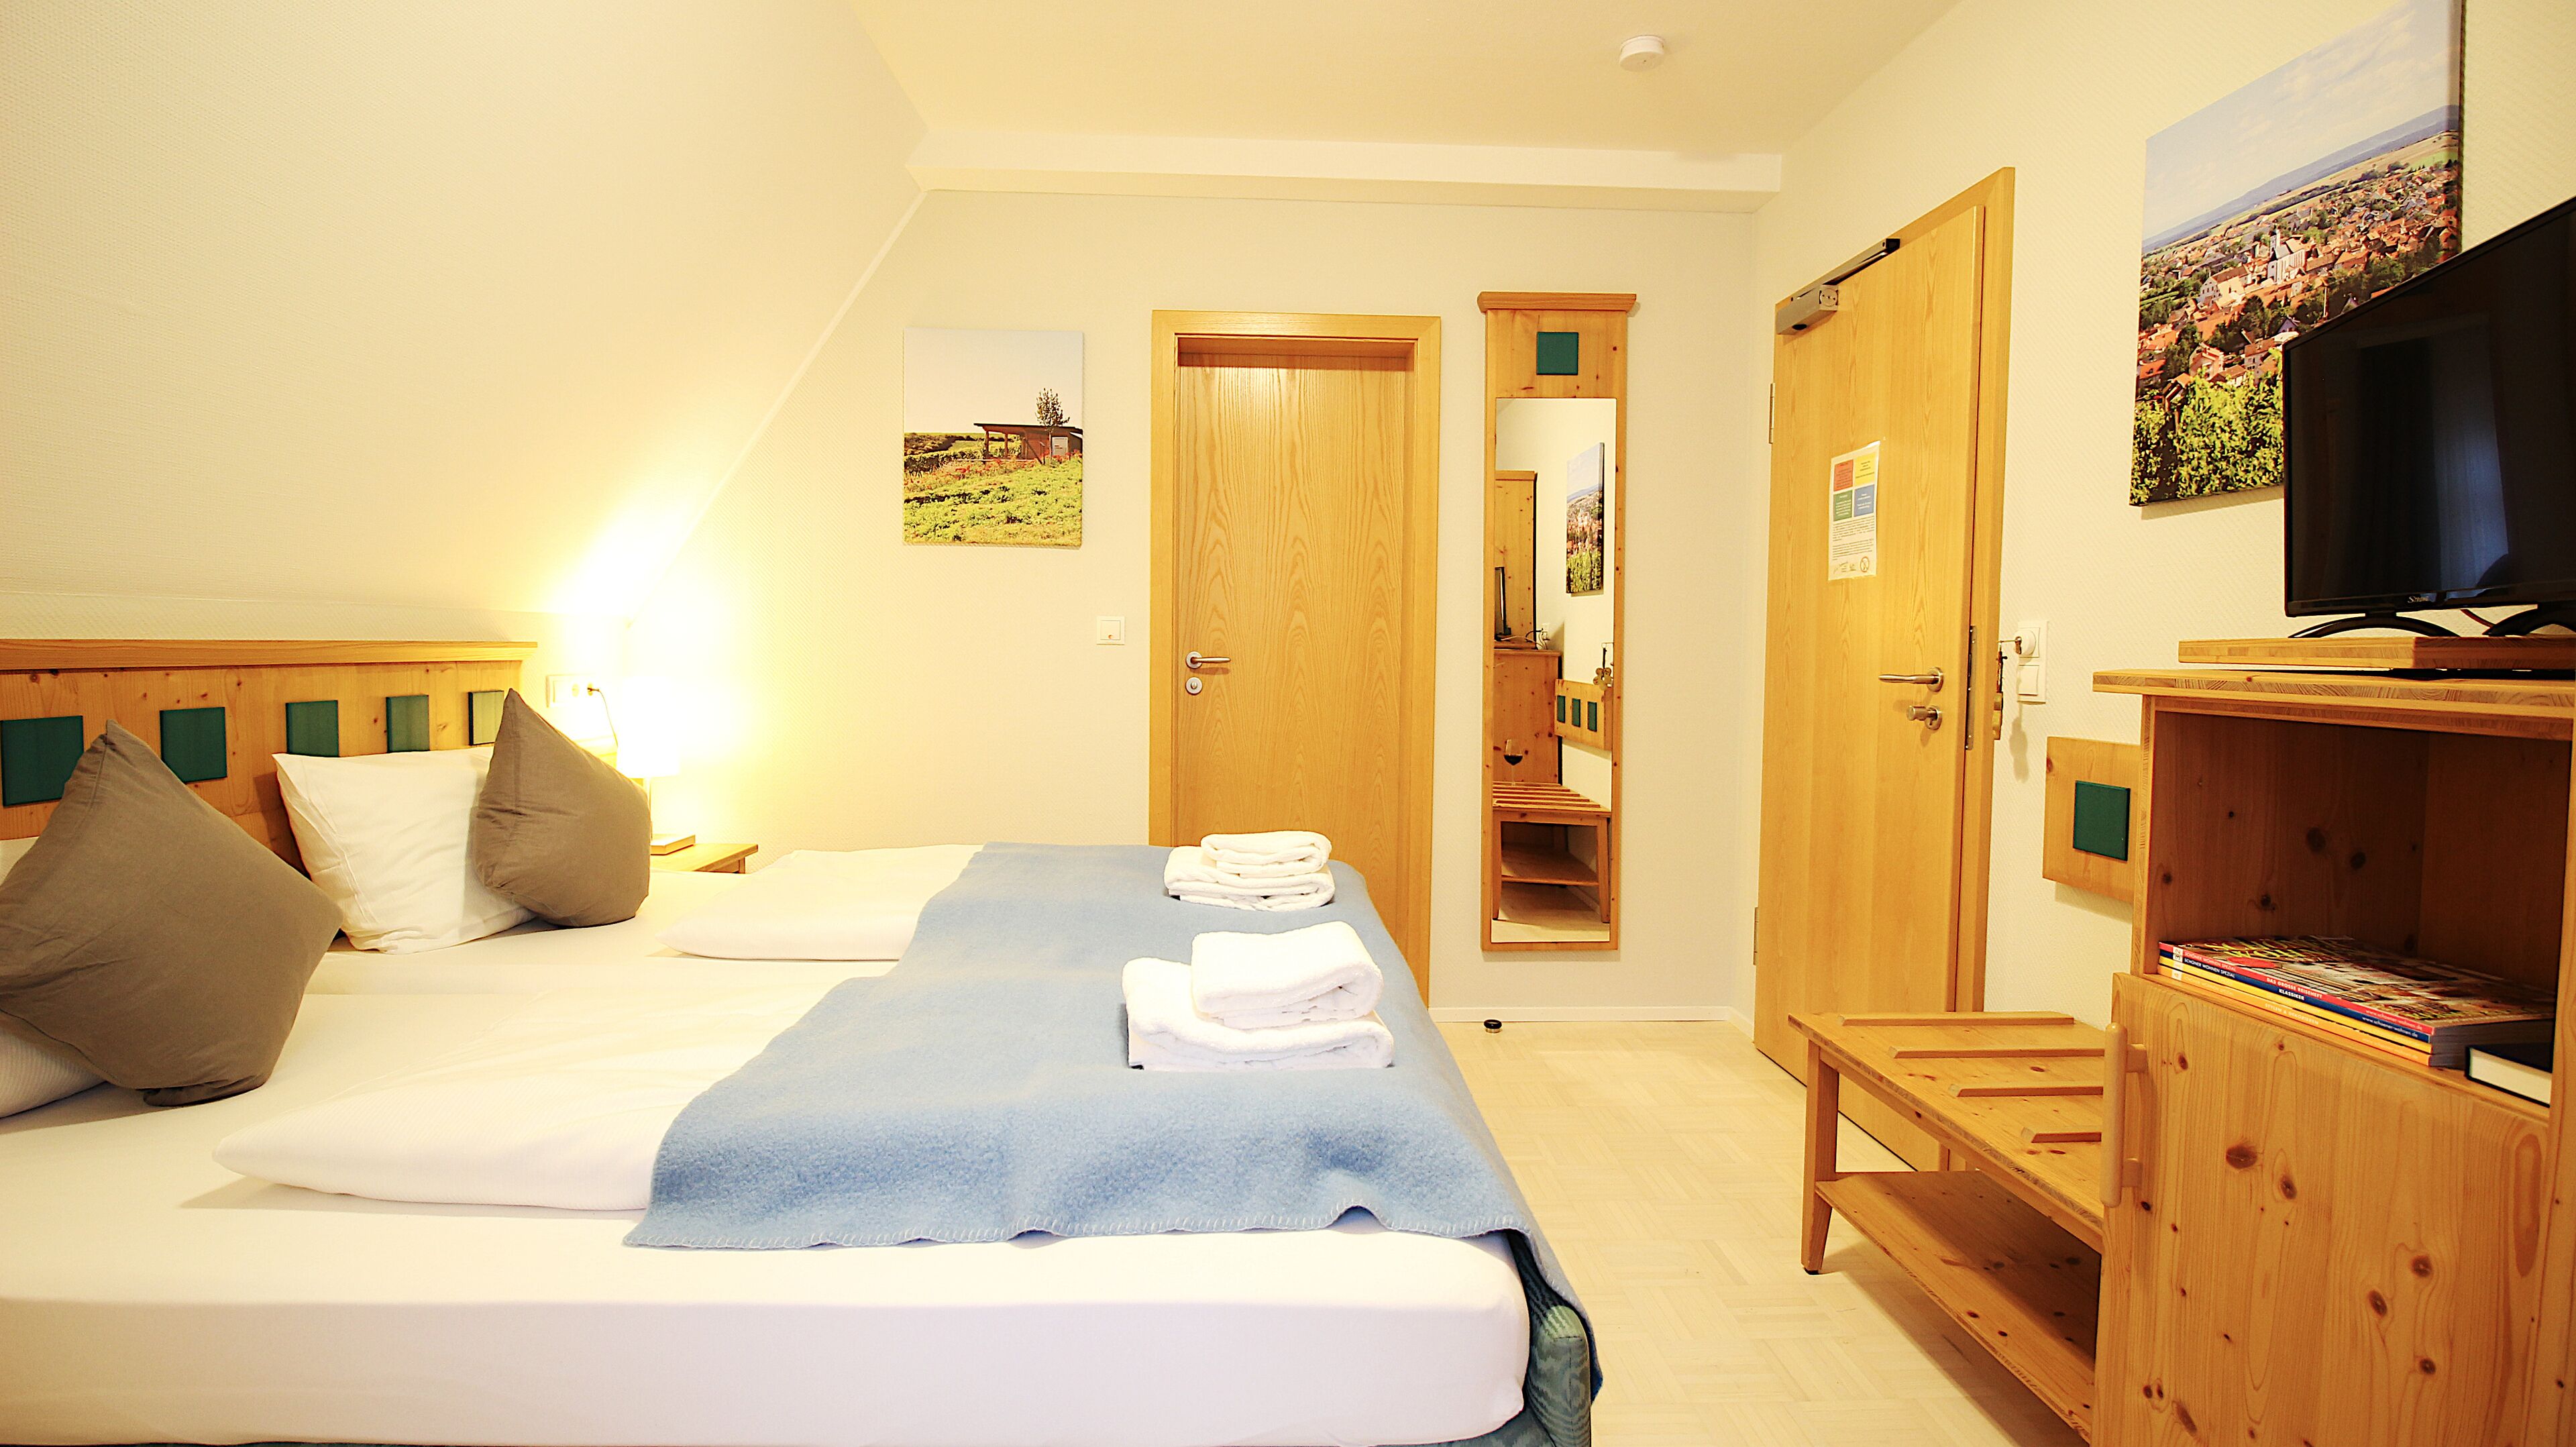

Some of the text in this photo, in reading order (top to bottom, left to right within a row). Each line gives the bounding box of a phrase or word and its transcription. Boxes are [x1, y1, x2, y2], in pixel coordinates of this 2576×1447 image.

[2184, 951, 2236, 971] SCHÖNER WOHNEN SPEZIAL
[2184, 958, 2235, 978] SCHÖNER WOHNEN SPEZIAL
[2277, 981, 2296, 989] GROSSE
[2298, 987, 2322, 998] REISEHEFT
[2279, 989, 2304, 1000] KLASSIKER
